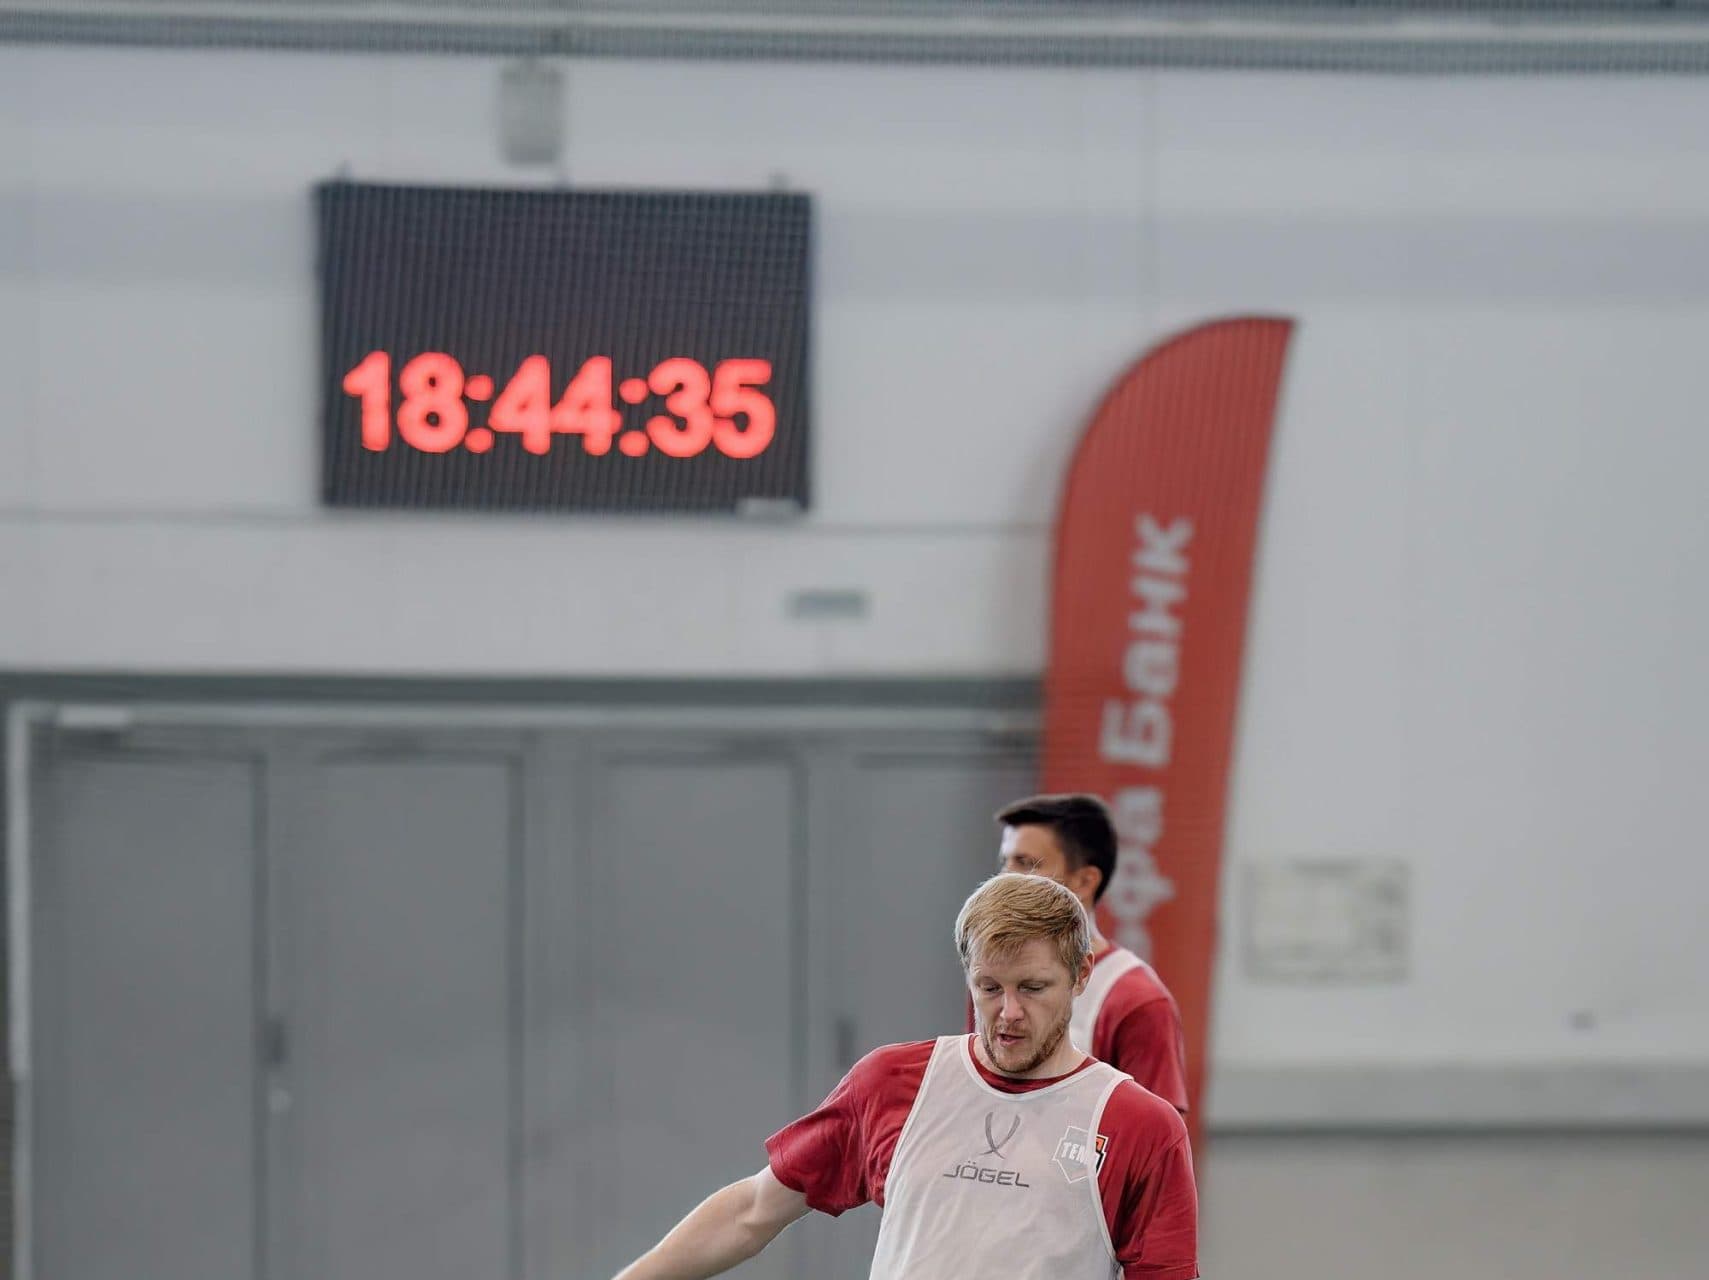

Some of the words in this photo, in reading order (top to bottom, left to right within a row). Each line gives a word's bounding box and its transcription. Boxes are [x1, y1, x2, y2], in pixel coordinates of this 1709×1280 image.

[342, 350, 777, 459] 18:44:35
[1098, 513, 1195, 768] Банк
[943, 1160, 1030, 1188] JÖGEL
